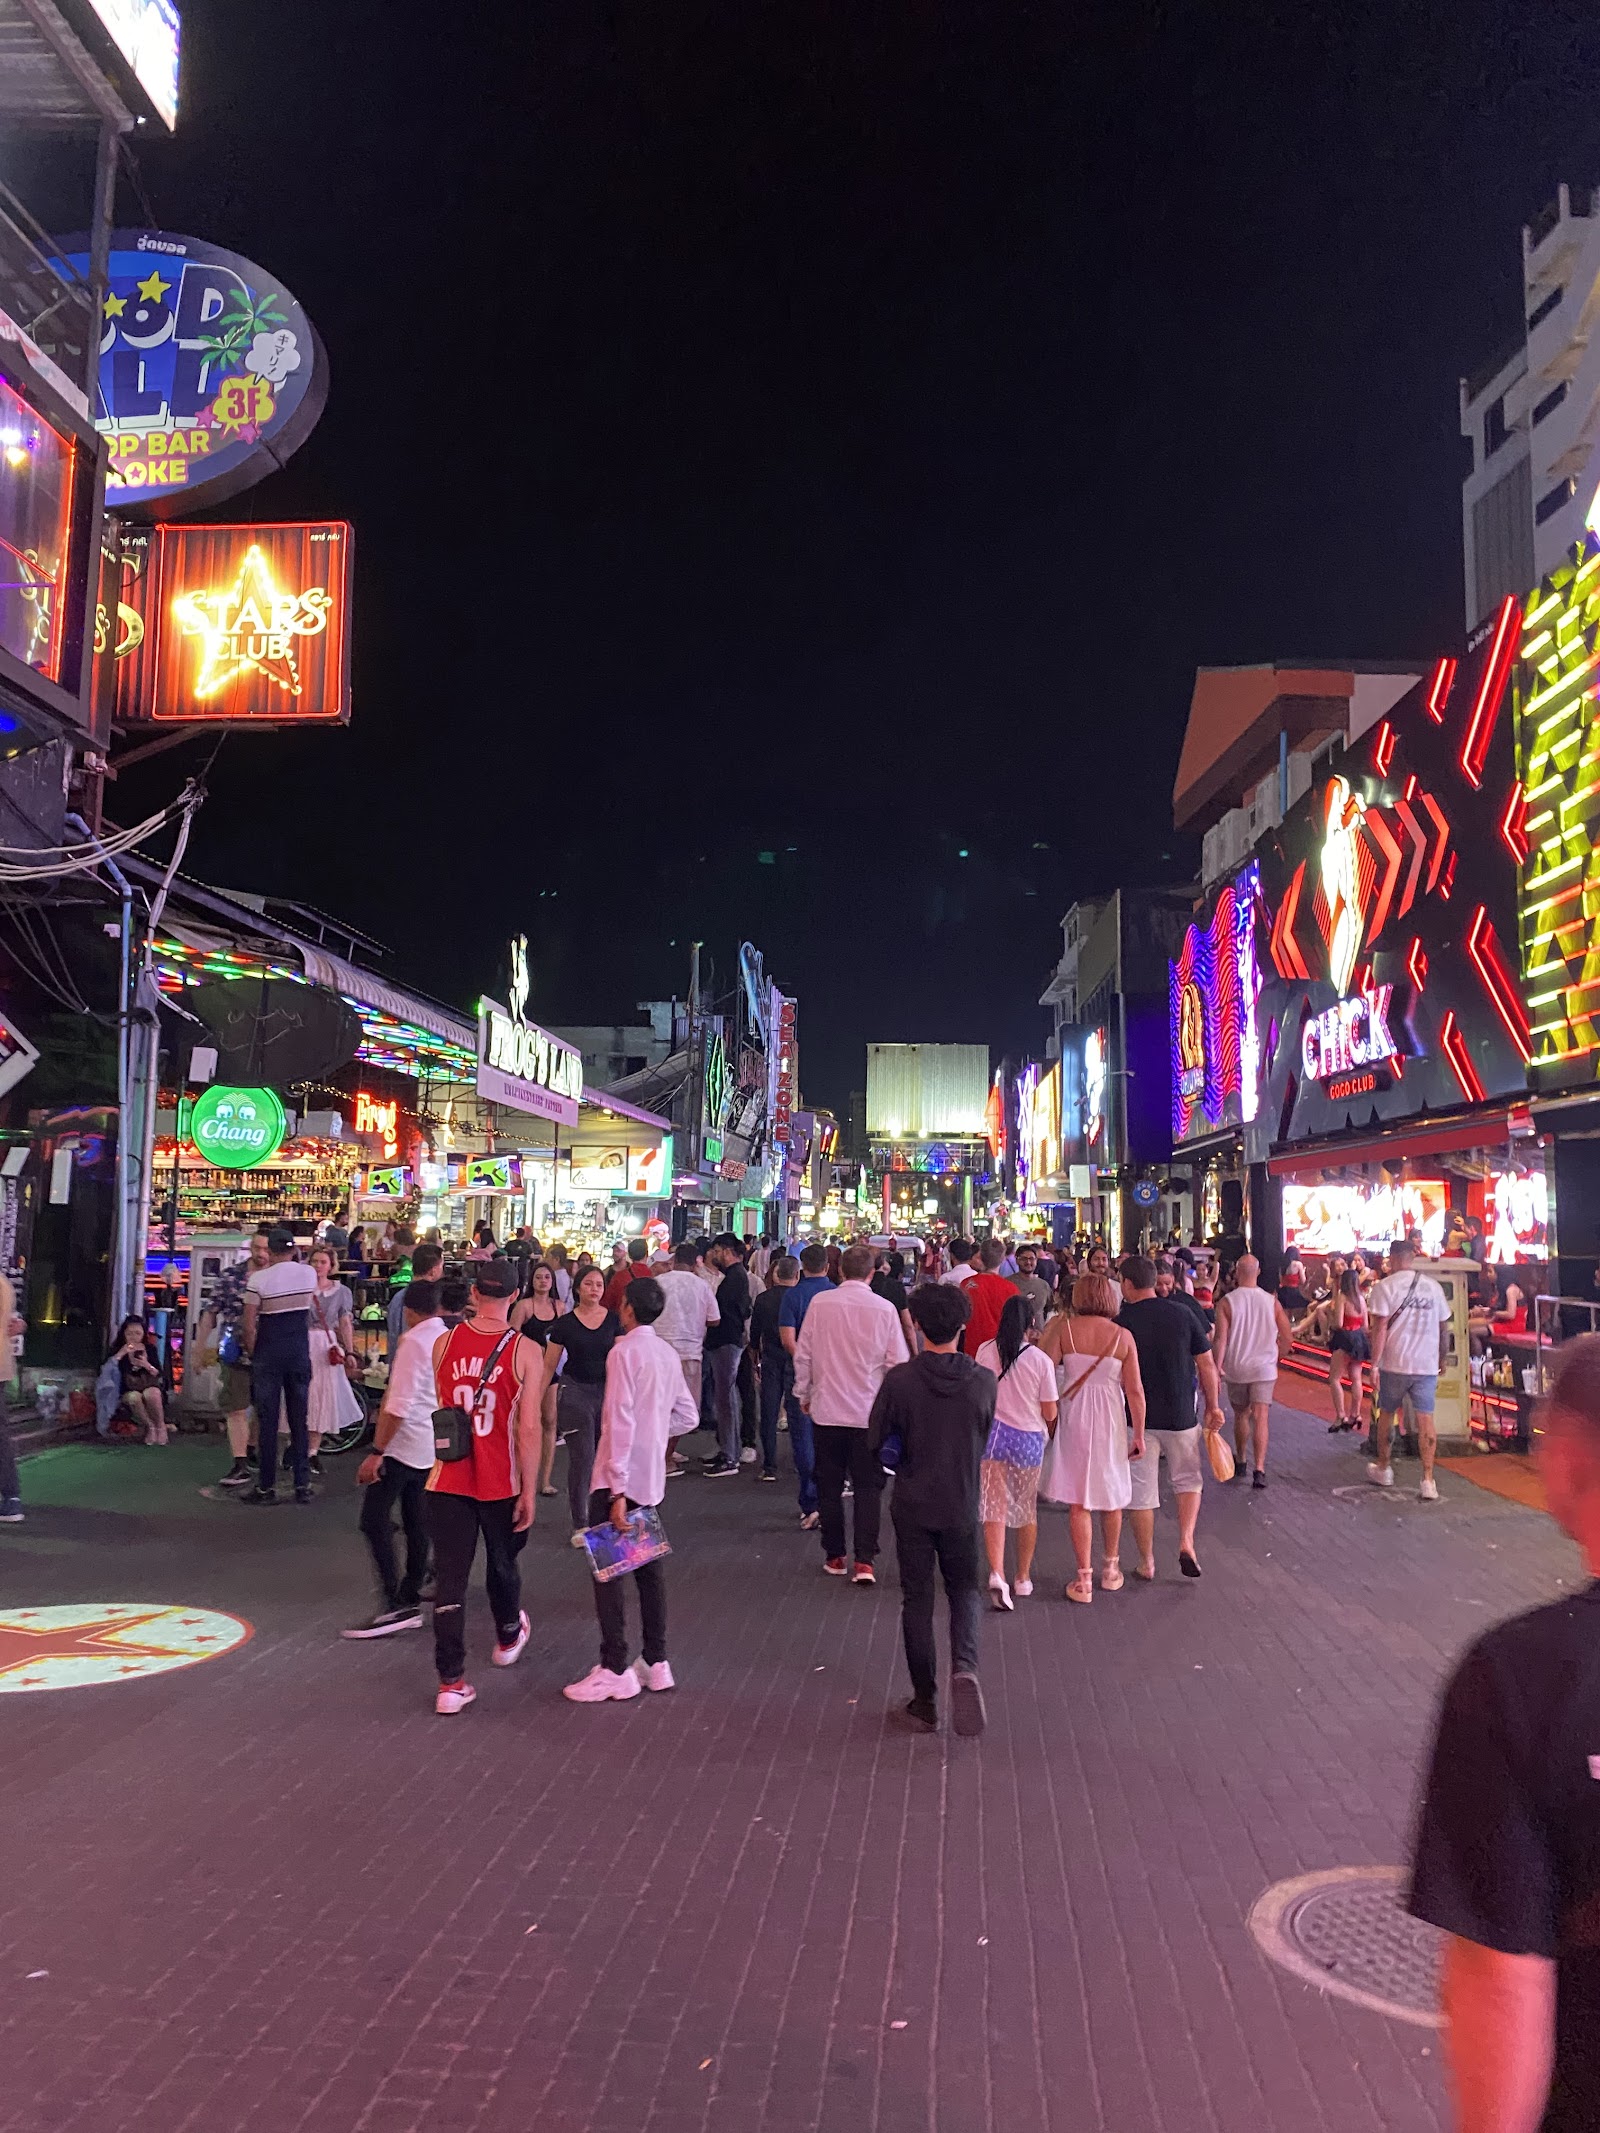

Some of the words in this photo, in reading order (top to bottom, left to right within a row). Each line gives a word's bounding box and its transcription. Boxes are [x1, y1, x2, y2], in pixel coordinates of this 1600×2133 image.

[227, 387, 261, 421] 3F
[147, 429, 211, 457] BAR
[104, 458, 188, 487] AOKE
[182, 587, 328, 636] STARS
[214, 635, 290, 661] CLUB
[779, 1003, 796, 1060] SEA
[489, 1010, 548, 1086] FROG'S
[549, 1043, 583, 1103] LAND
[1330, 1083, 1351, 1101] GOGO
[1352, 1073, 1376, 1095] CLUB
[775, 1071, 793, 1142] ZONE
[201, 1119, 266, 1146] Chang
[452, 1356, 504, 1384] JAMS
